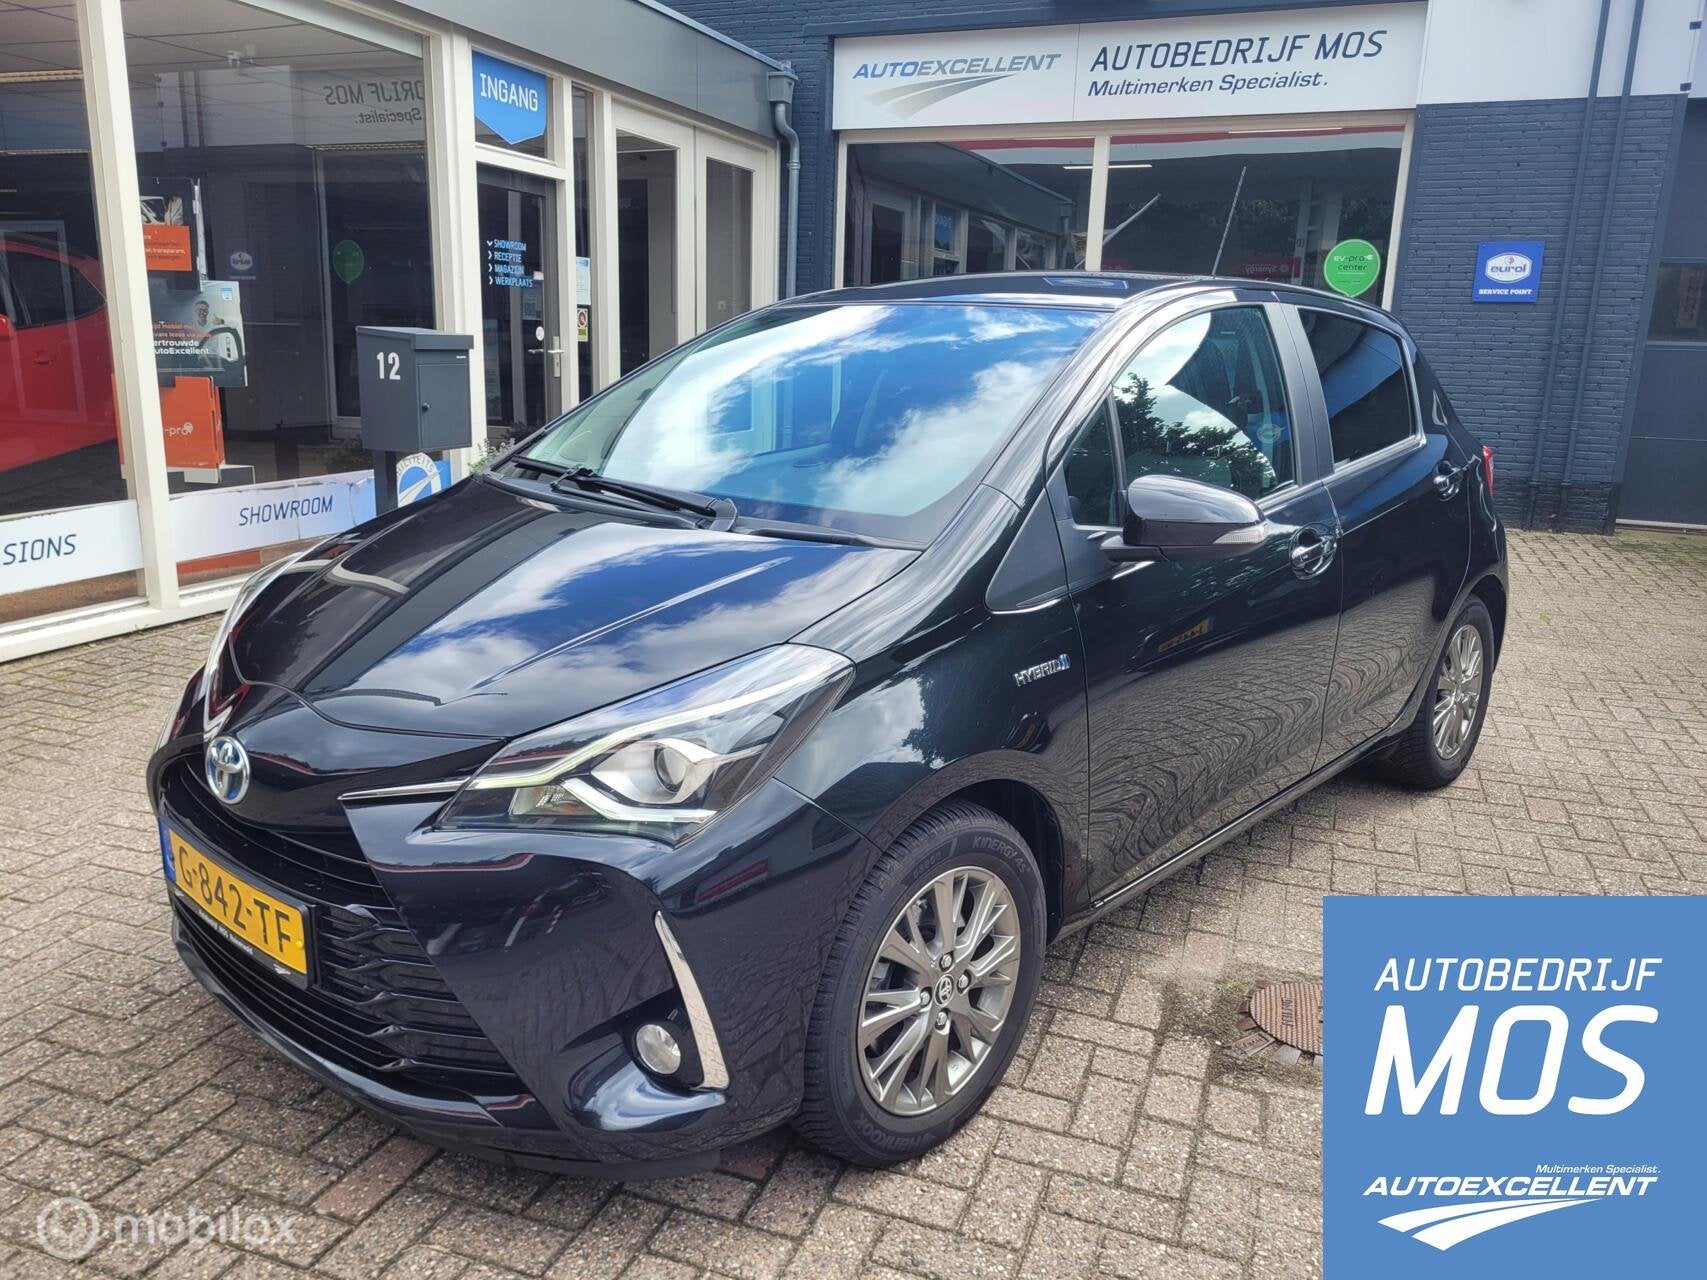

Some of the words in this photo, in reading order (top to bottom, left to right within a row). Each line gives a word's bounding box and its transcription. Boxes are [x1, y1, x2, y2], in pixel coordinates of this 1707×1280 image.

[1090, 34, 1310, 72] AUTOBEDRIJF
[1314, 30, 1387, 60] MOS
[853, 53, 1062, 80] AUTOEXCELLENT
[480, 73, 538, 112] INGANG
[1088, 75, 1213, 97] Multimerken
[1219, 70, 1328, 94] Specialist.
[494, 239, 527, 251] SHOWROOM
[494, 251, 522, 263] RECEPTIE
[495, 276, 534, 288] WERKPLAATS
[1490, 264, 1527, 273] eurol
[376, 351, 401, 380] 12
[239, 495, 333, 526] SHOWROOM
[3, 534, 77, 566] SIONS
[1014, 659, 1061, 687] HYBRID
[178, 846, 291, 953] G-842-TF
